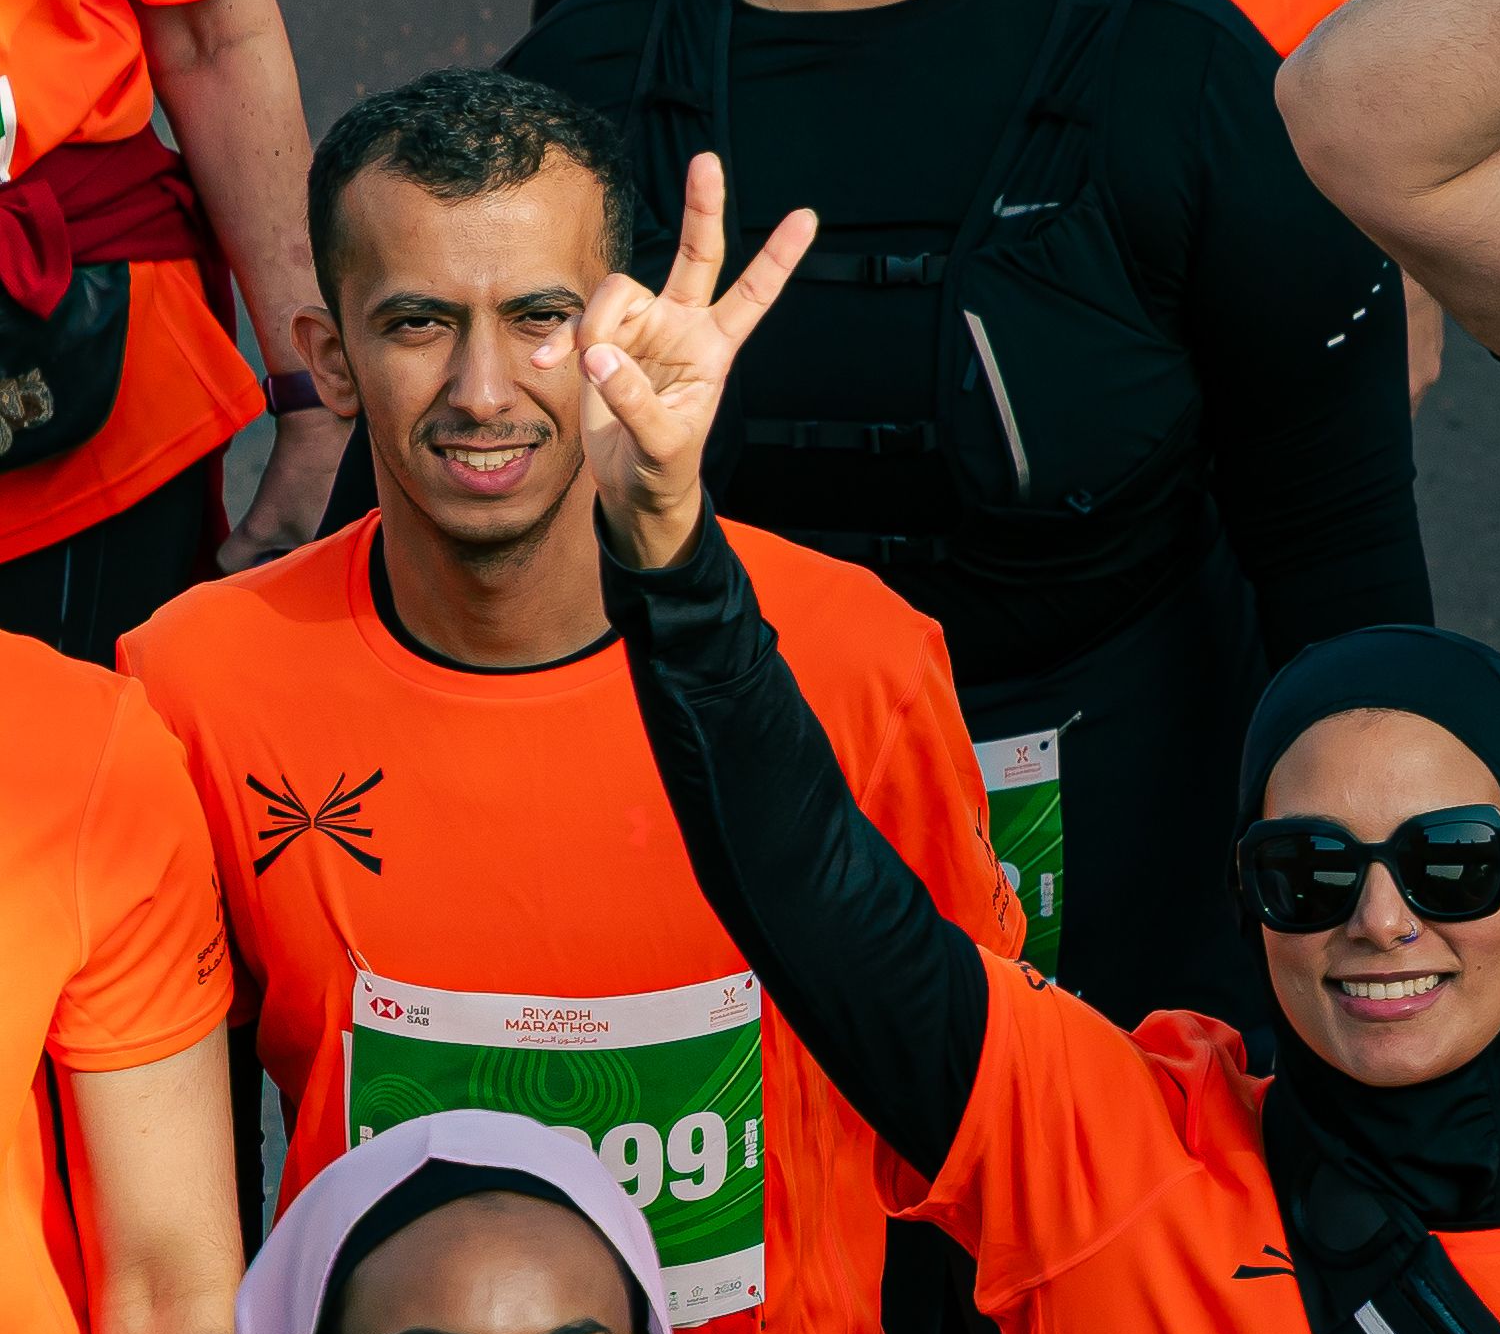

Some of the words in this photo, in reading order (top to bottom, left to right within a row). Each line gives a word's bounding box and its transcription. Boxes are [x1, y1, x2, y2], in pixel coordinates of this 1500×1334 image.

[406, 1015, 430, 1027] SAB
[521, 1007, 593, 1022] RIYADH
[505, 1019, 610, 1034] MARATHON
[546, 1111, 729, 1209] 99
